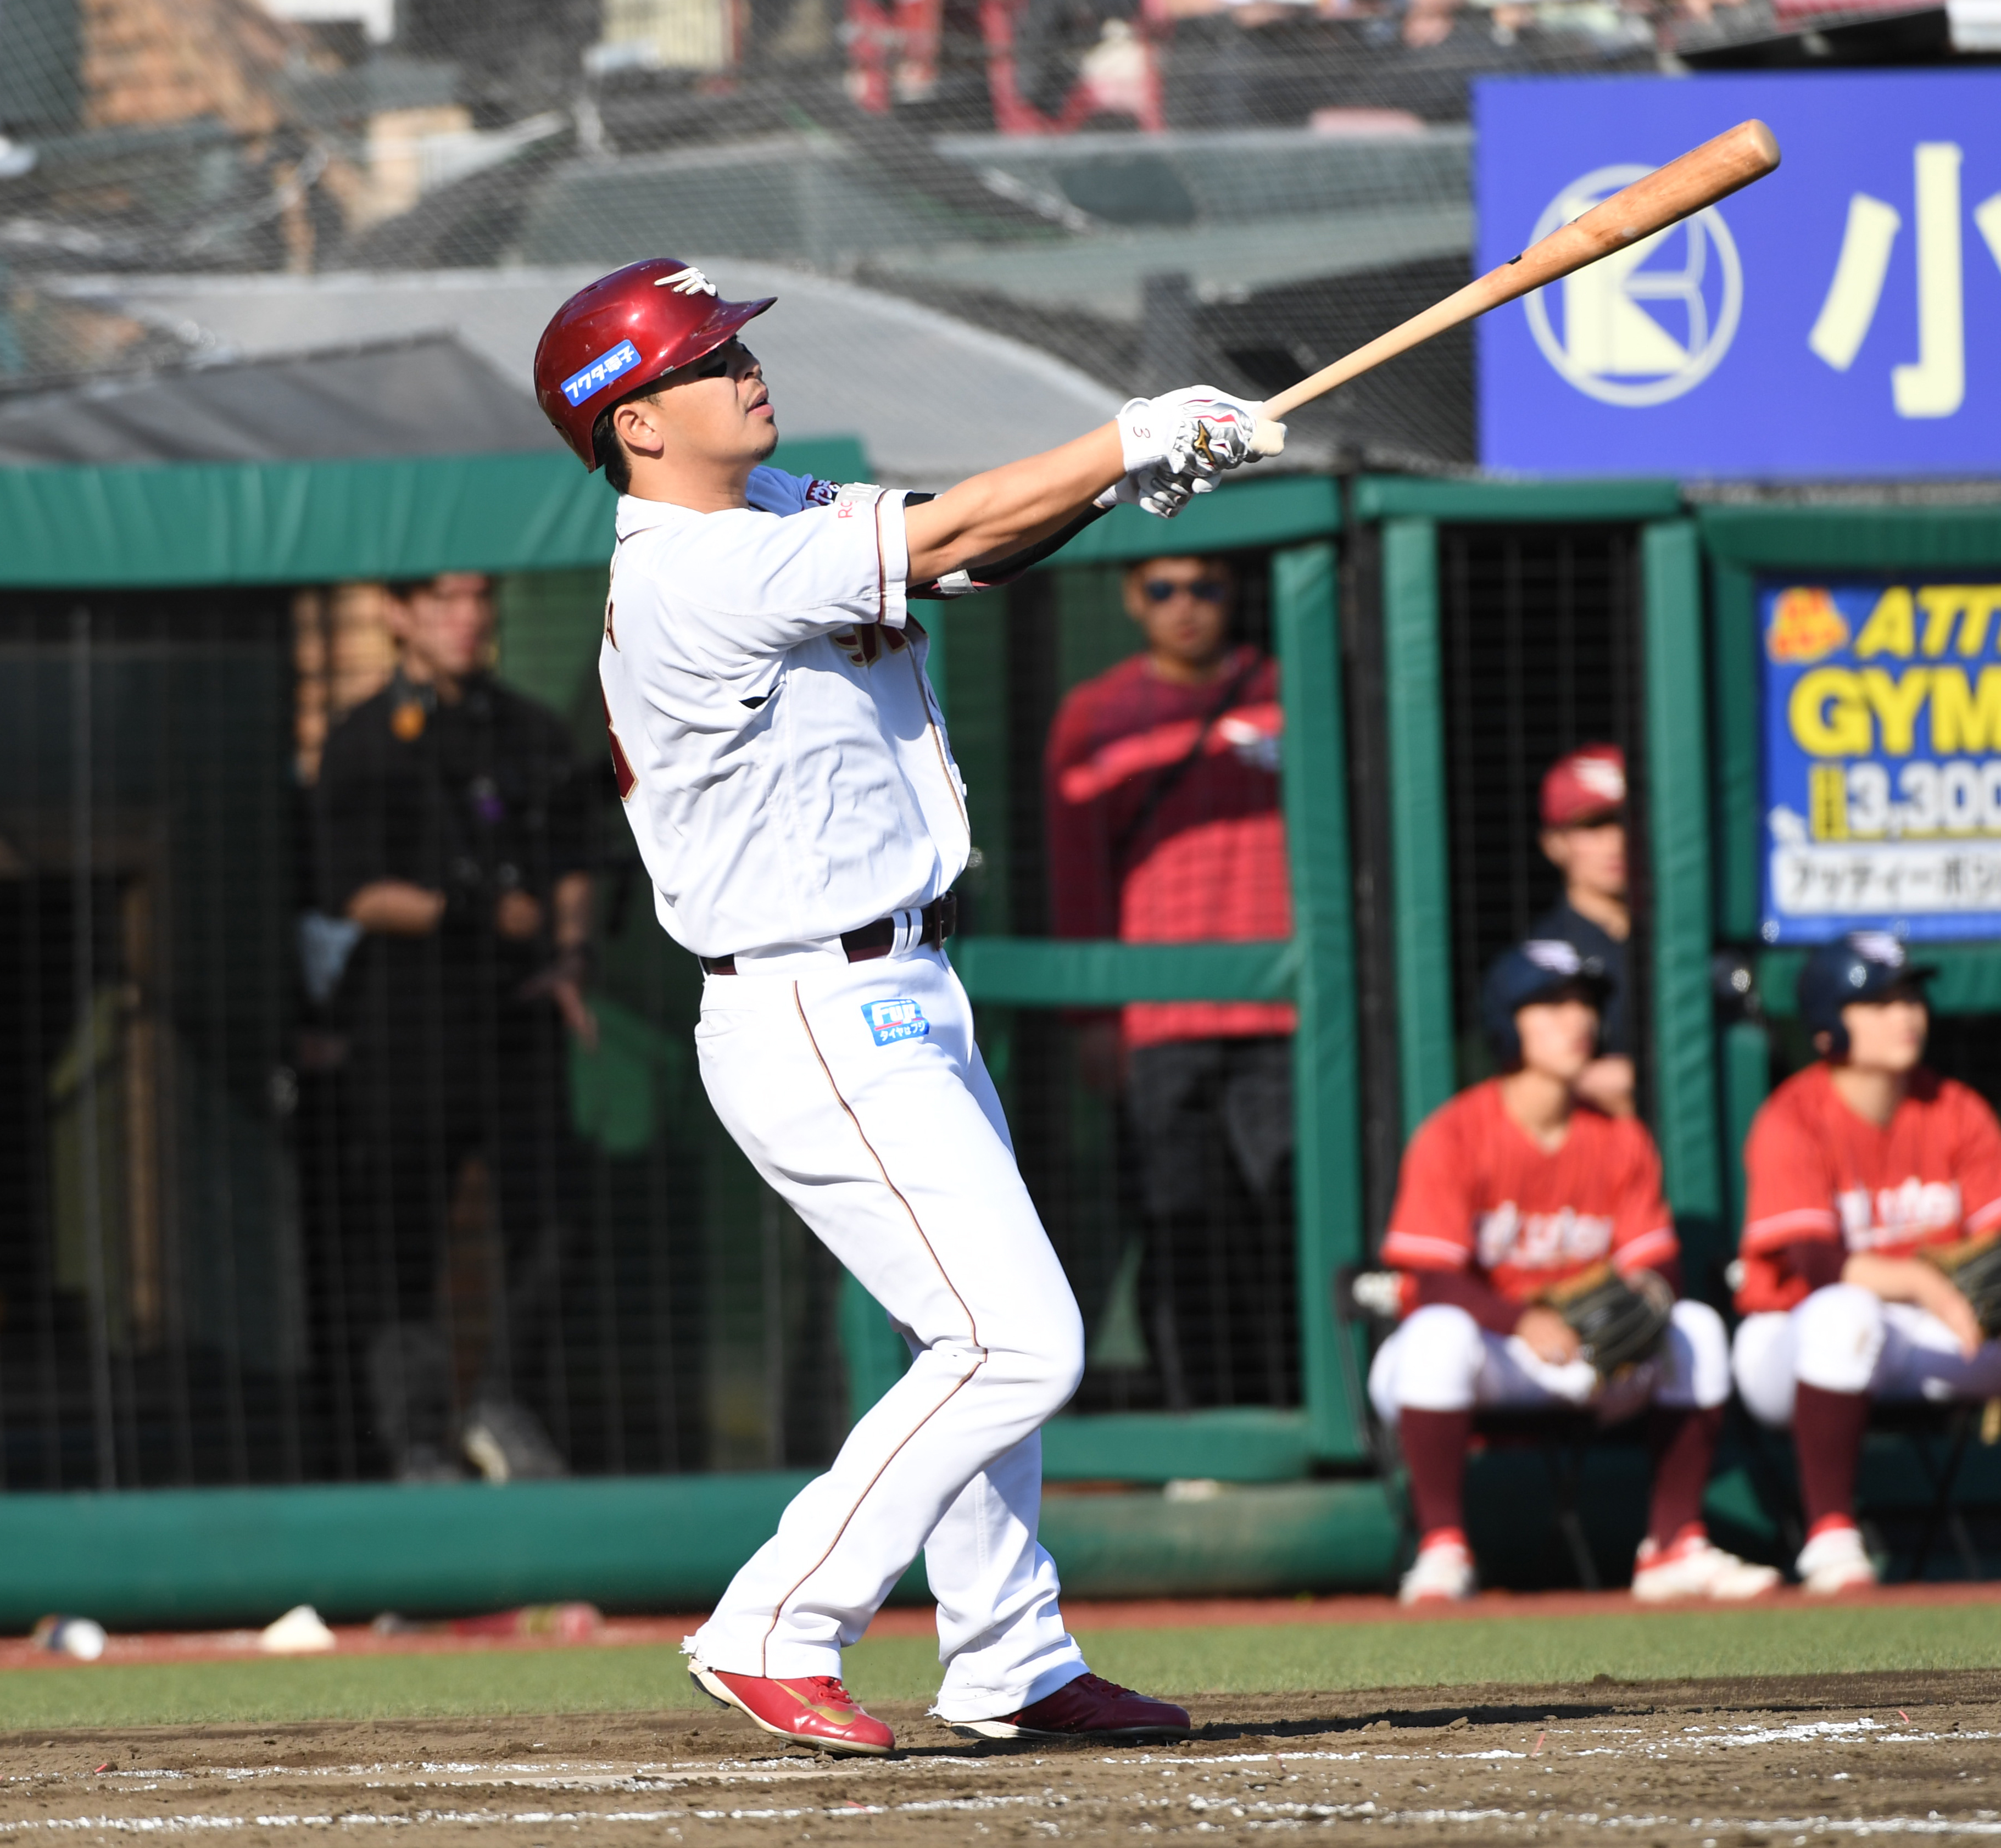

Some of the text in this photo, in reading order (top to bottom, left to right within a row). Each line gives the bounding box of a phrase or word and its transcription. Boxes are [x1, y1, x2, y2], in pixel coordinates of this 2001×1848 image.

[1853, 583, 2001, 659] ATT
[1788, 665, 2001, 757] GYM
[880, 1020, 926, 1042] タイヤはフジ
